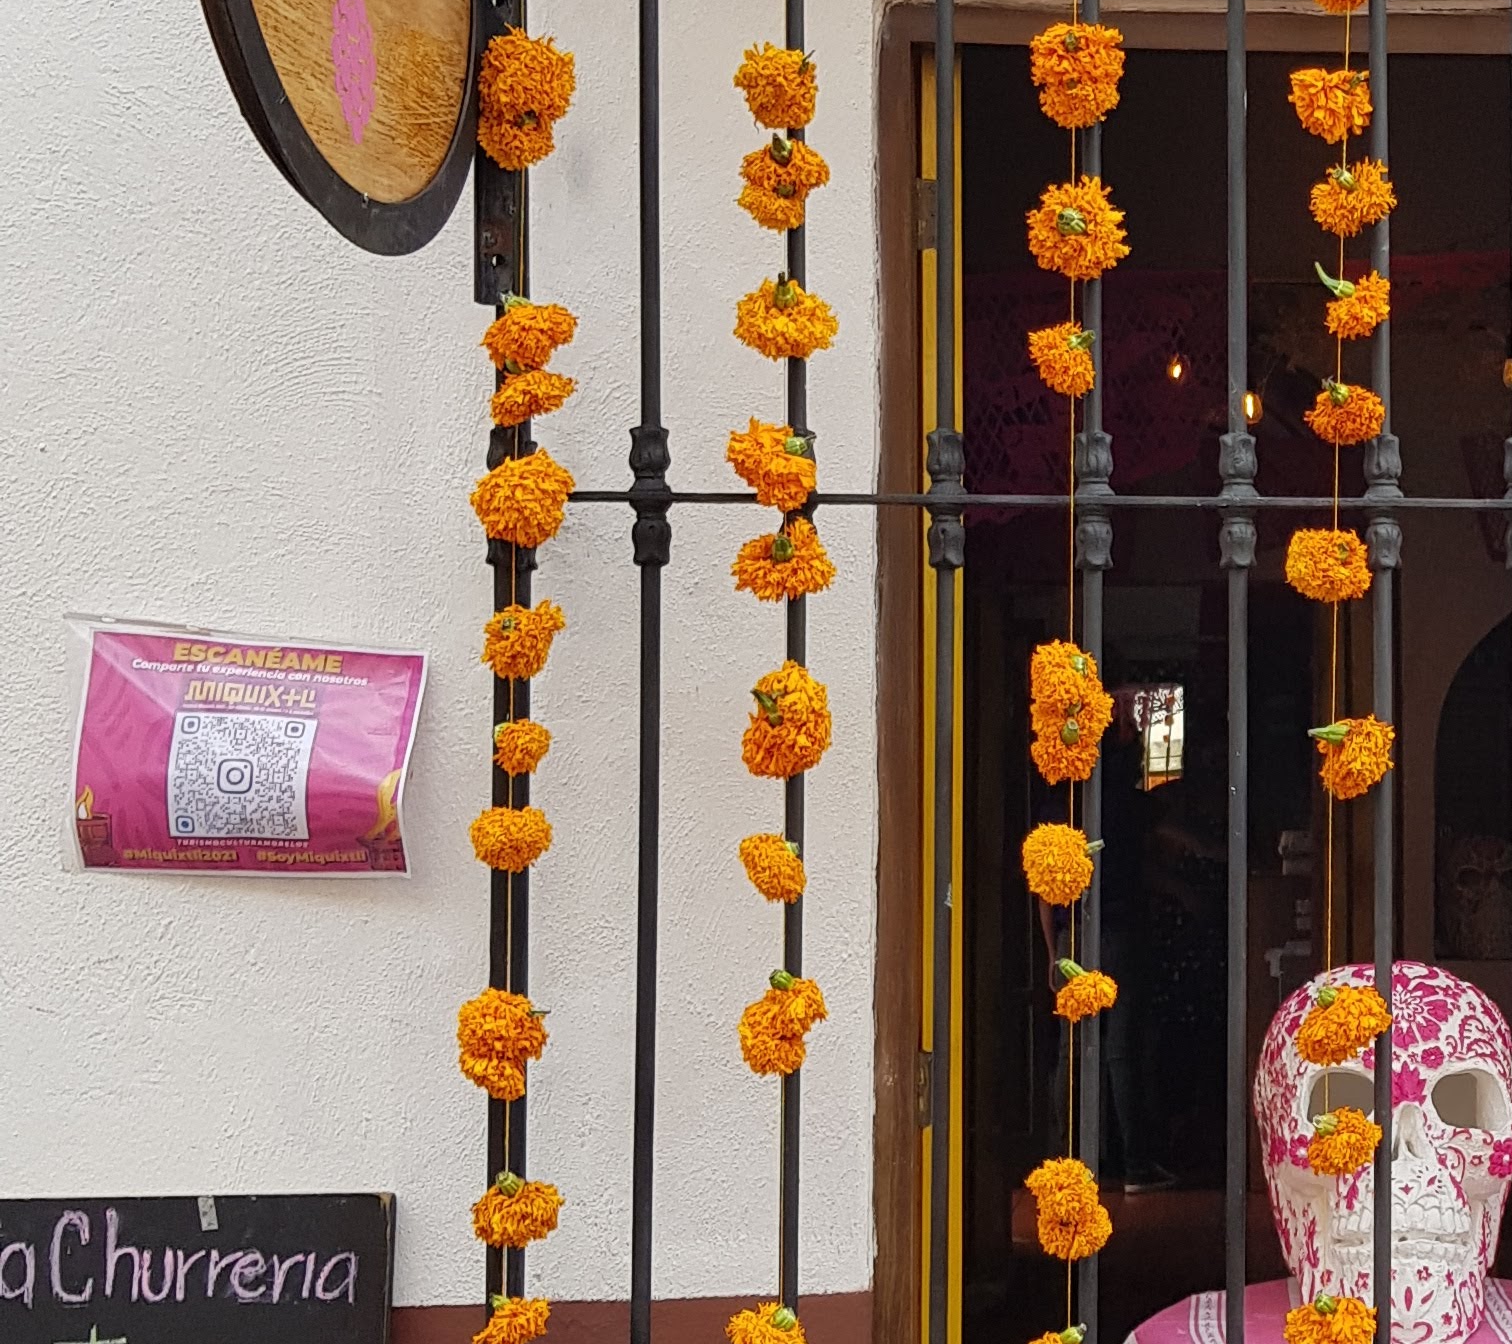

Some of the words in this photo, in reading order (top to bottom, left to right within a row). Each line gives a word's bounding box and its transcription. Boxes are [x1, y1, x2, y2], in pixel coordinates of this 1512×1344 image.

[131, 658, 194, 673] Comparte
[212, 665, 285, 681] experiencia
[288, 672, 311, 682] con
[313, 674, 369, 686] nosotros
[173, 642, 343, 673] ESCANÉAME
